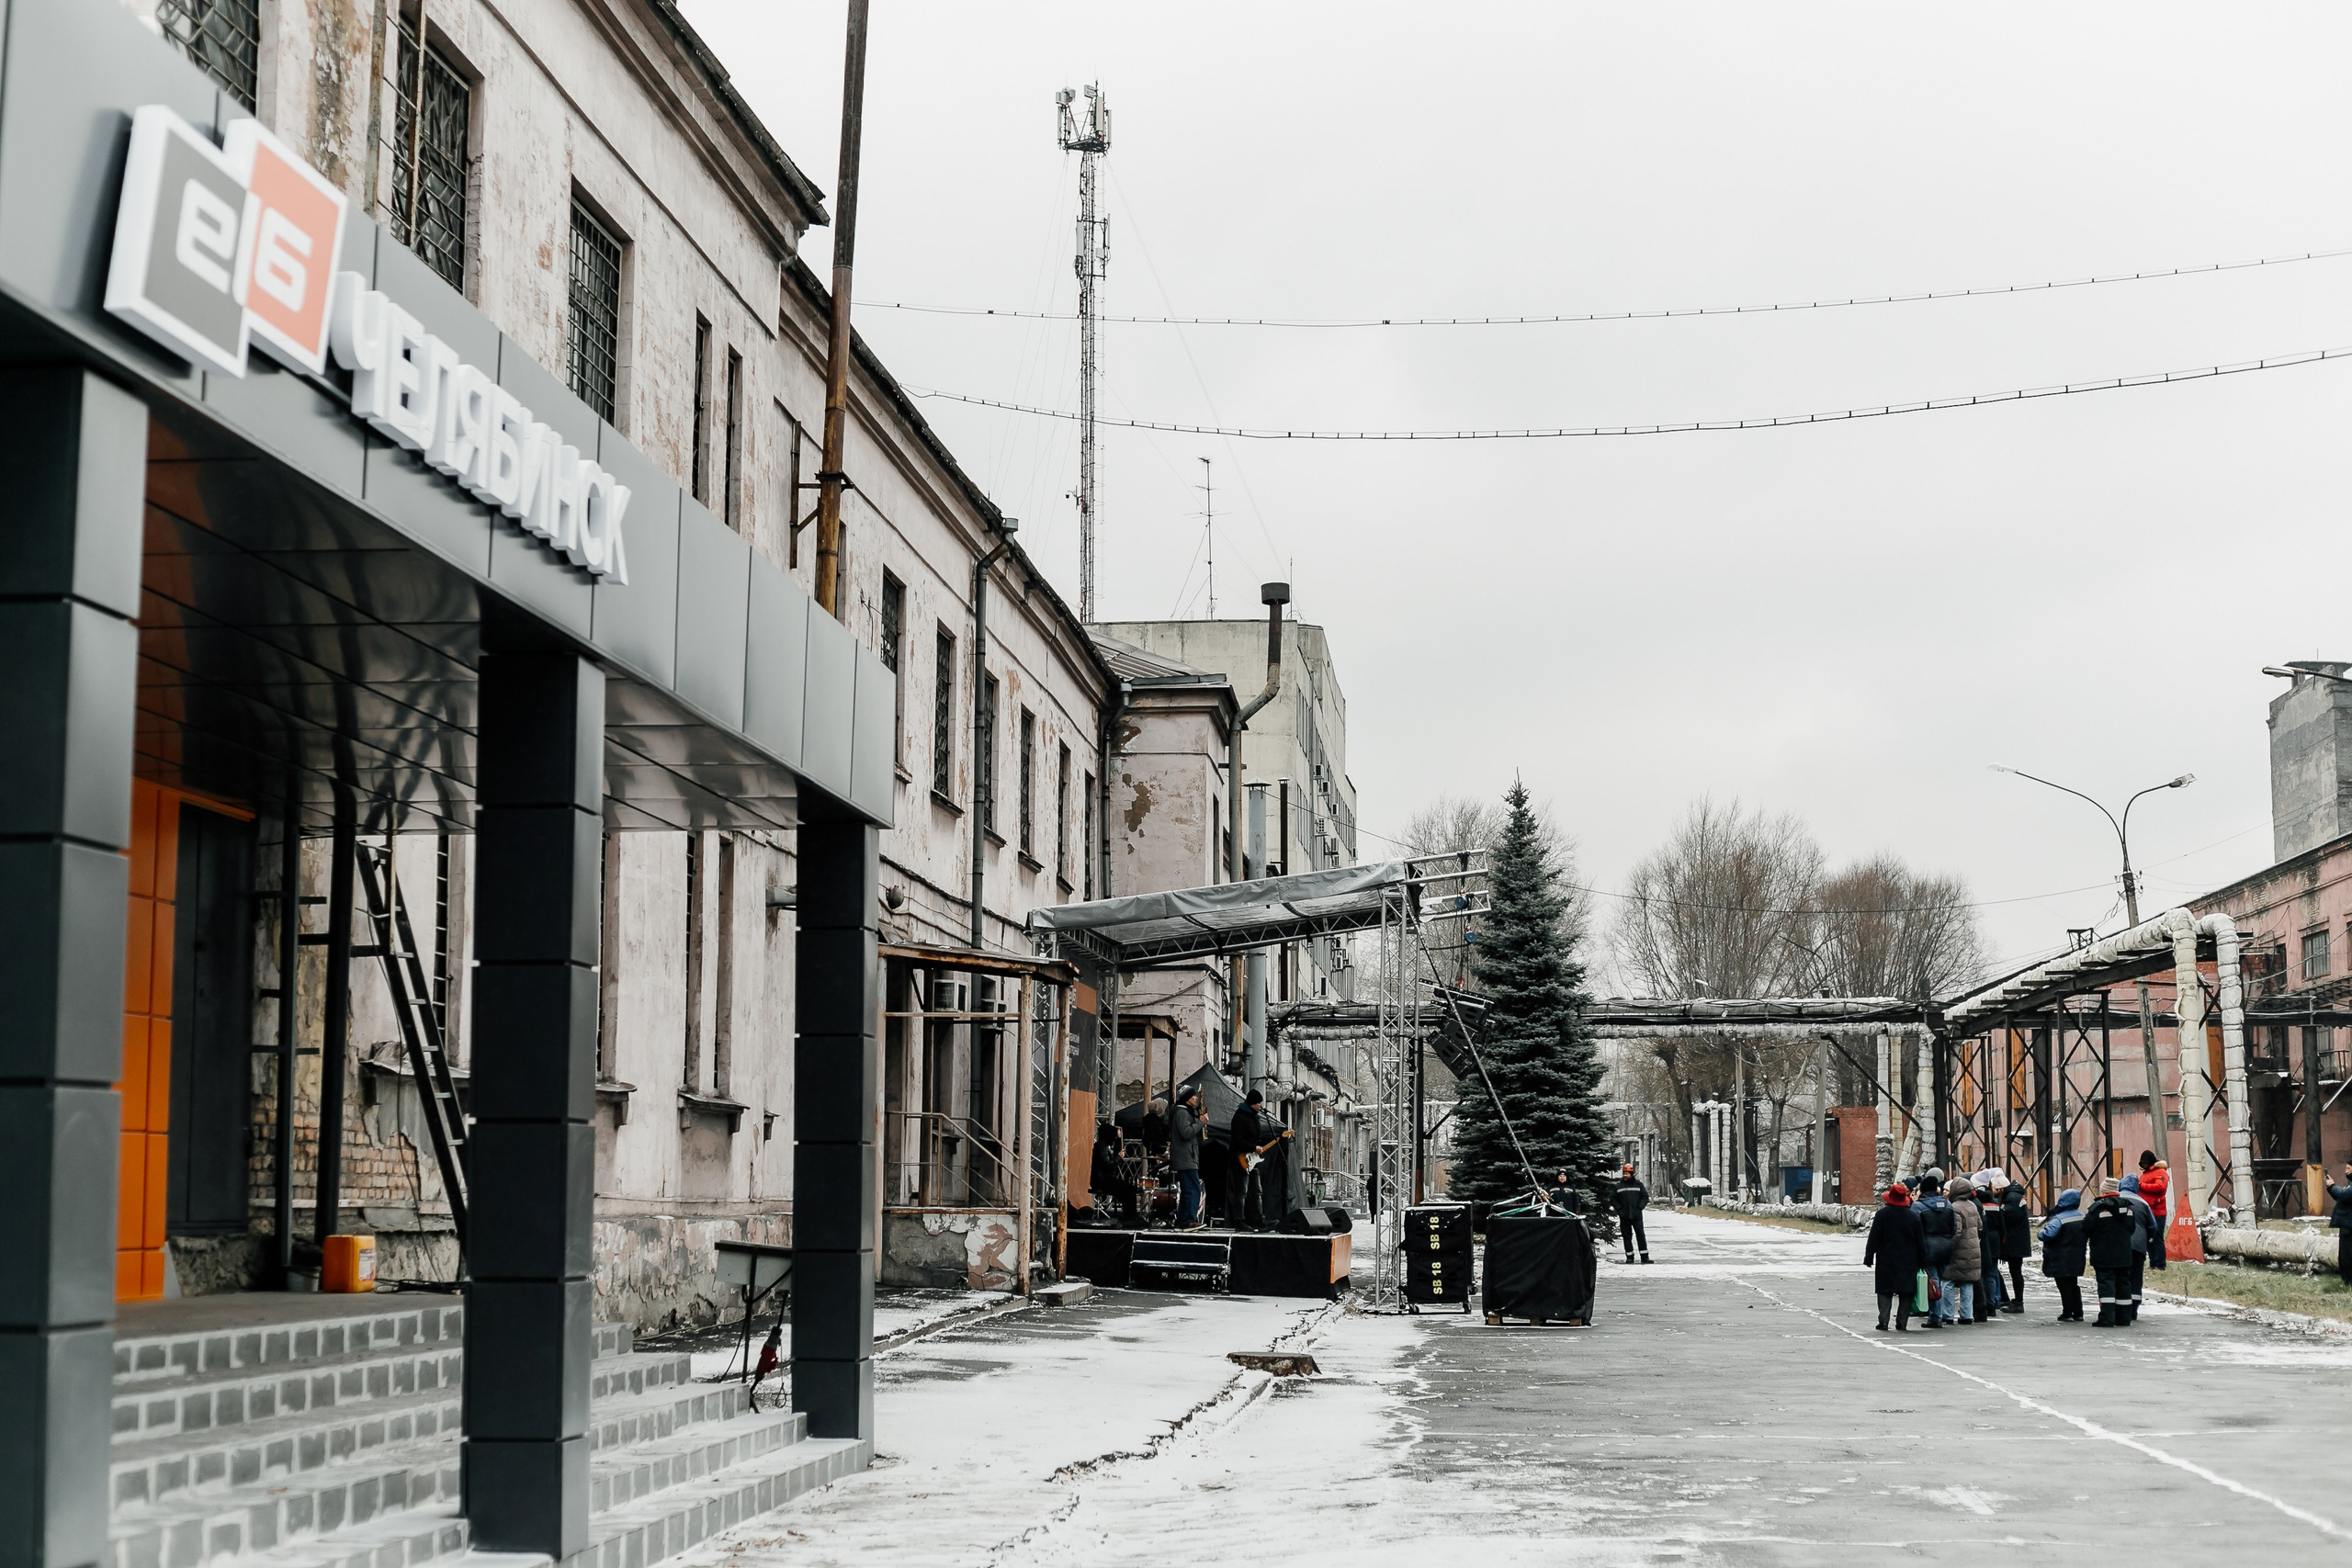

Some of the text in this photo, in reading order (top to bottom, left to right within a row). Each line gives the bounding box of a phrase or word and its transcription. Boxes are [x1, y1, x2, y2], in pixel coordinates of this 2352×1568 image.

[332, 272, 632, 586] ЧЕЛЯБИНСК
[1430, 1216, 1440, 1249] SB 18
[1431, 1261, 1442, 1294] SB 18
